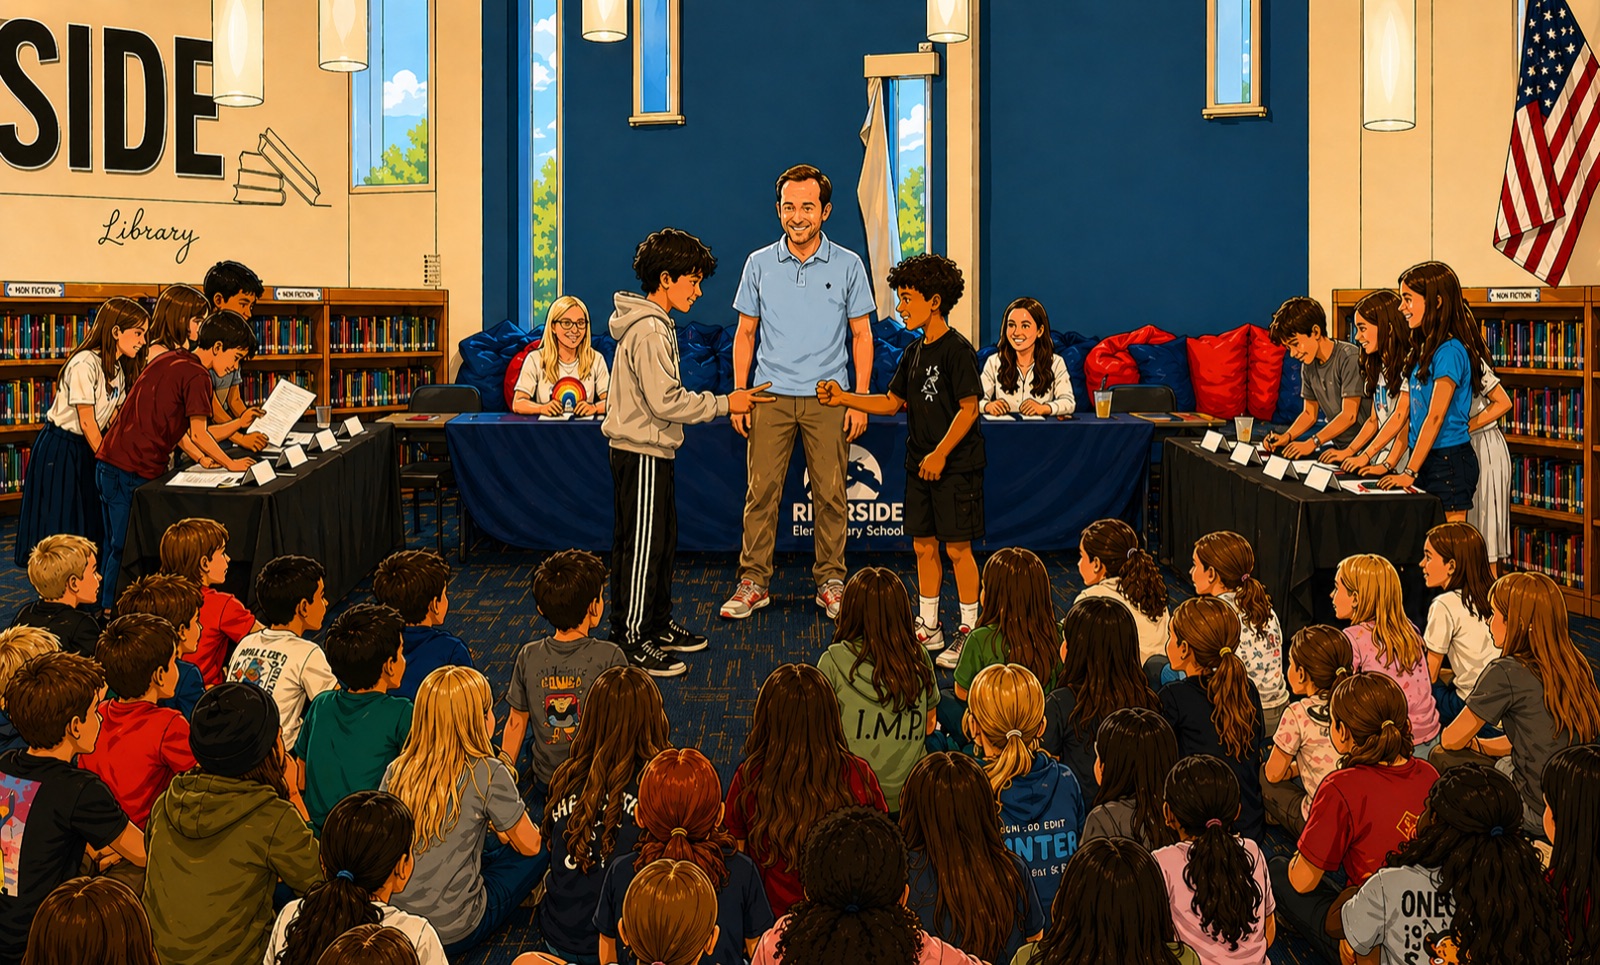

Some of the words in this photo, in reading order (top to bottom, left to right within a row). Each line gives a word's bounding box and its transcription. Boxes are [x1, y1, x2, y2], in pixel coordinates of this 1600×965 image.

[0, 17, 224, 180] SIDE
[98, 208, 200, 264] Library
[793, 503, 904, 522] RIRSIDE
[866, 525, 904, 536] School
[856, 708, 923, 740] I.M.P.
